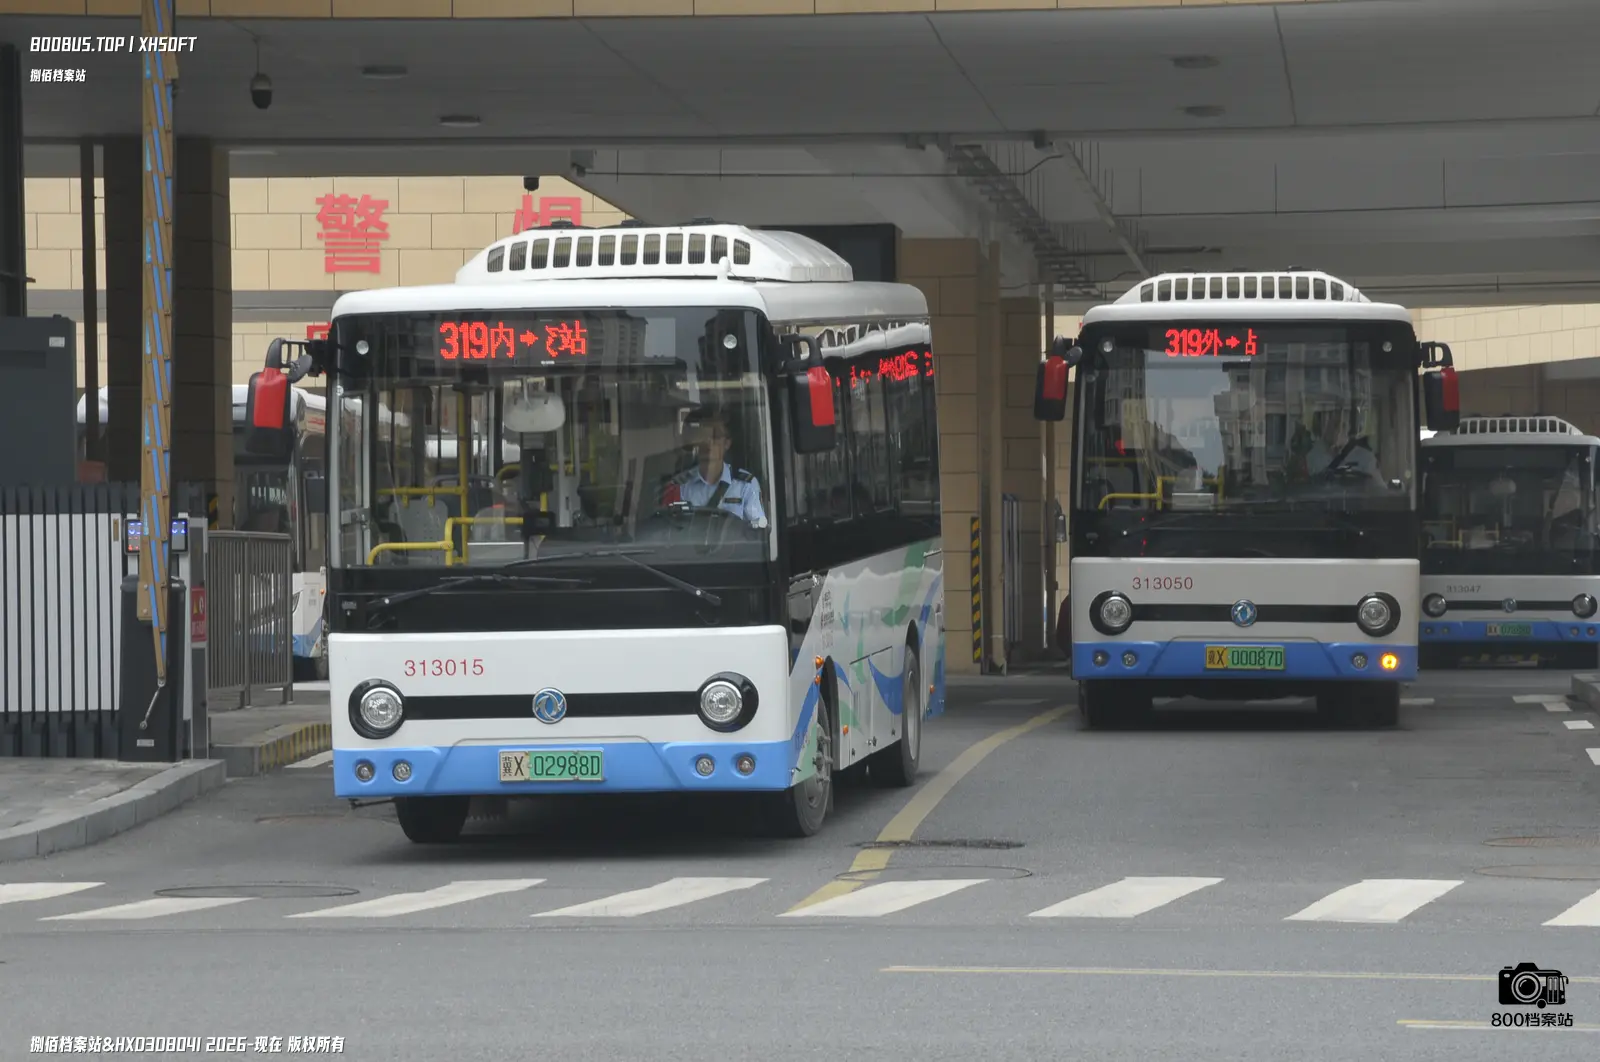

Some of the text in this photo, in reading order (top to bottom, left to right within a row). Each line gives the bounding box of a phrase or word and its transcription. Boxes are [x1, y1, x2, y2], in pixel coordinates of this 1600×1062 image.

[315, 194, 390, 275] 警
[439, 321, 515, 359] 319内
[1165, 328, 1223, 357] 319外
[1132, 577, 1193, 590] 313050
[404, 659, 484, 677] 313015
[534, 755, 600, 777] 02988D
